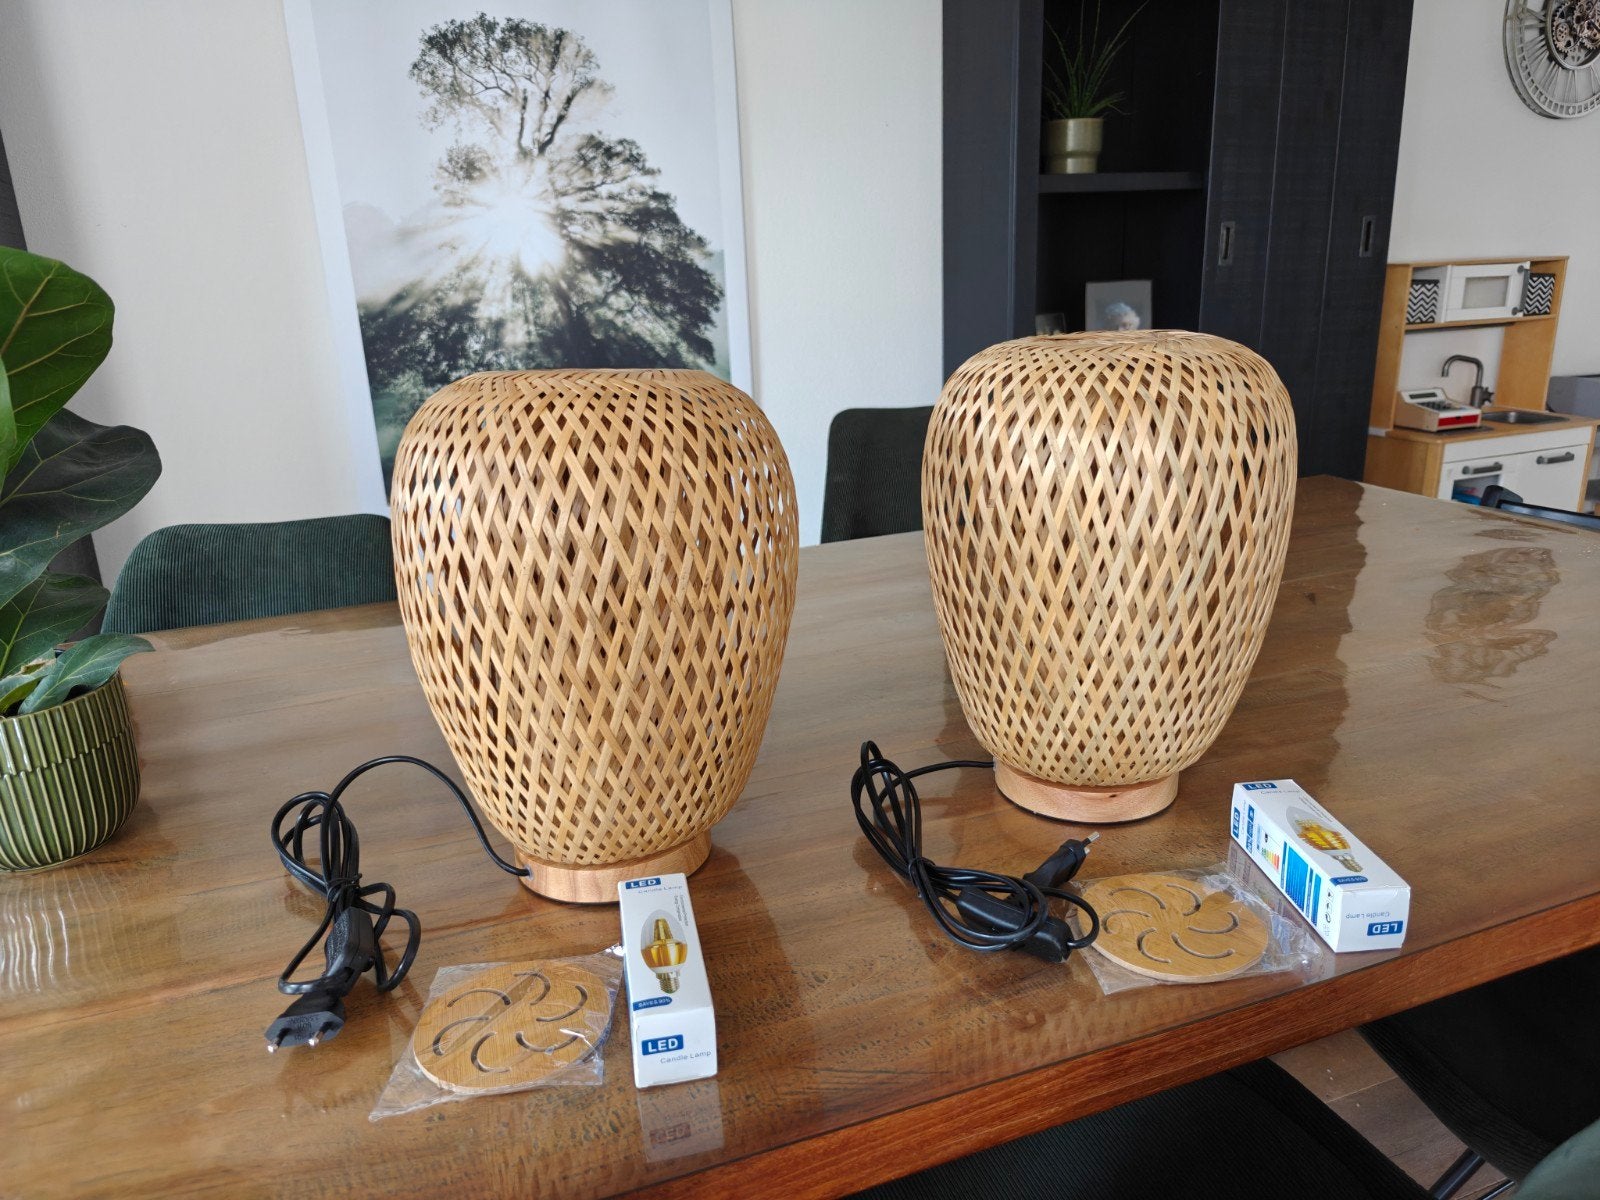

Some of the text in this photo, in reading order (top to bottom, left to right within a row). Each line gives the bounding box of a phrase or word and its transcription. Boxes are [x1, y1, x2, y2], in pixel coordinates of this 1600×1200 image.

[630, 879, 657, 888] LED
[1366, 911, 1390, 919] Candle
[1372, 923, 1398, 934] LED
[647, 1038, 679, 1053] LED
[660, 1050, 712, 1064] Candle Lamp
